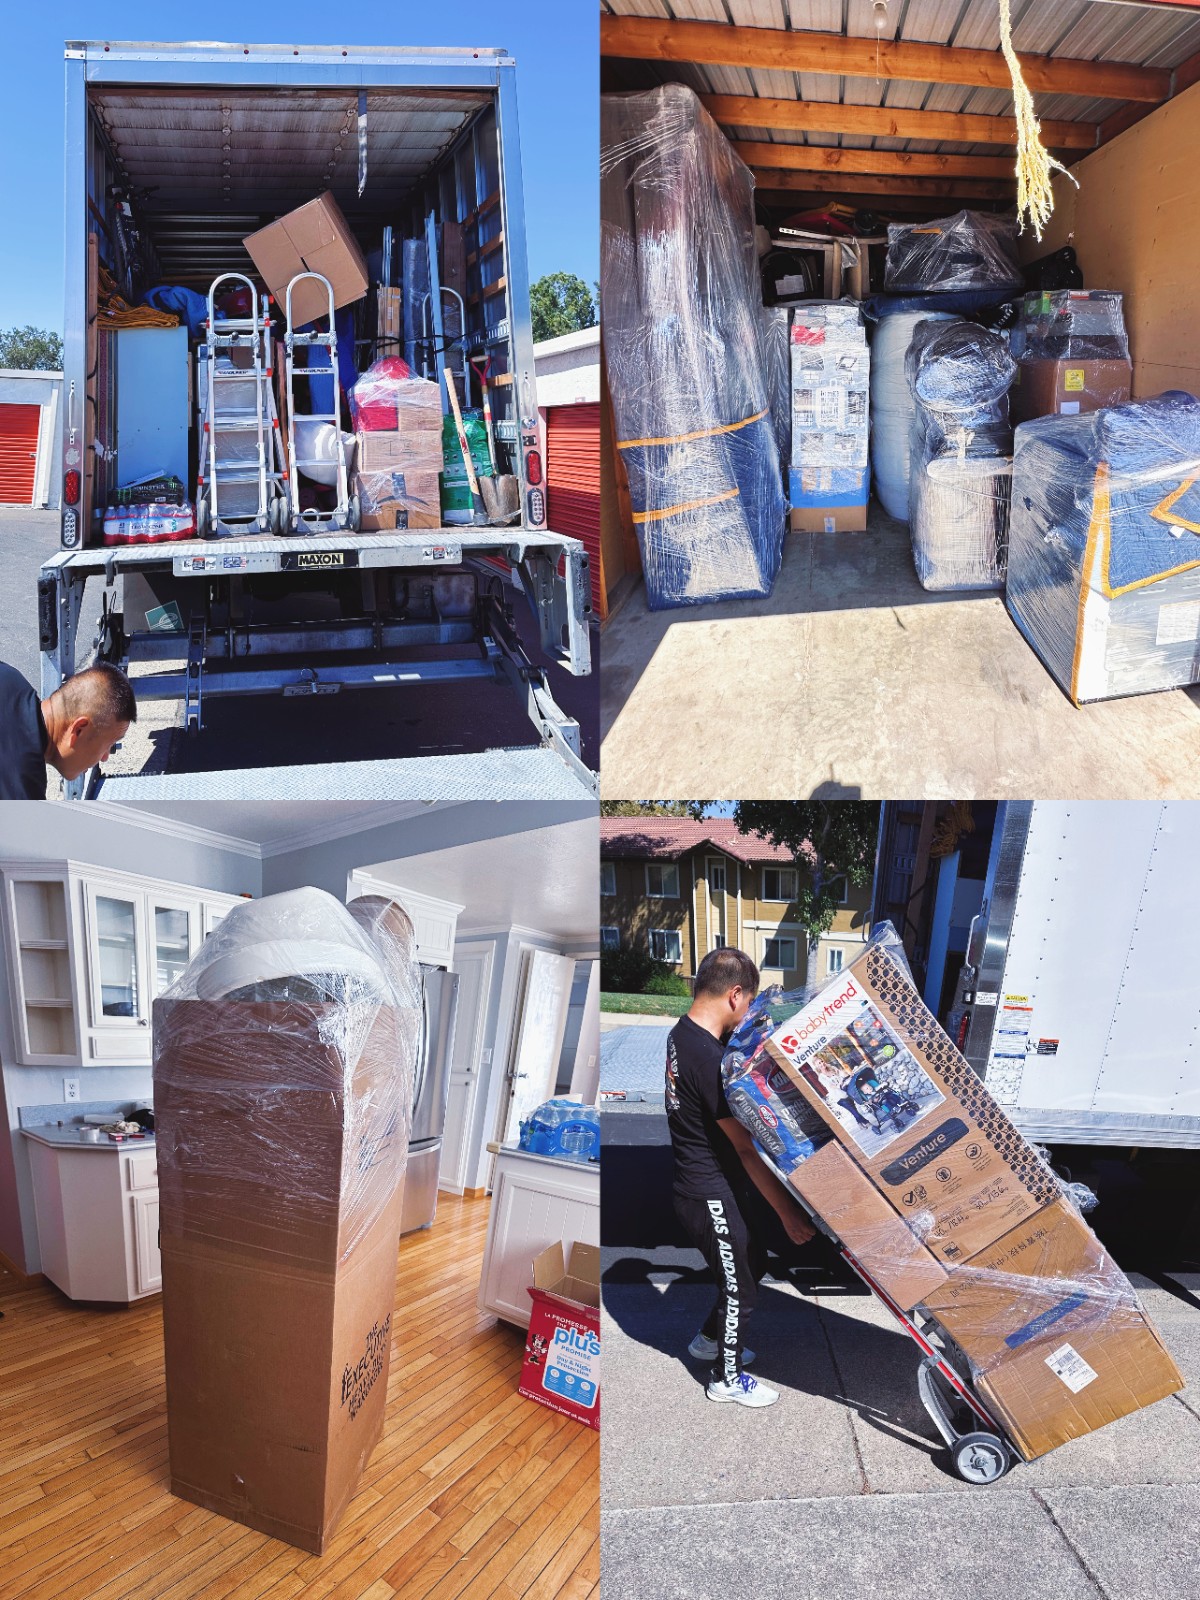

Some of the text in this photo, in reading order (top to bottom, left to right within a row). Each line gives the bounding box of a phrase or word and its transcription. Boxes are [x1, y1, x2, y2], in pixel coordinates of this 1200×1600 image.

[299, 554, 341, 566] MAXON
[794, 981, 858, 1041] babytrend
[793, 1035, 827, 1065] Venture
[735, 1093, 780, 1153] PROFESSIONAL
[898, 1132, 947, 1170] Venture
[717, 1238, 738, 1293] ADIDAS
[723, 1295, 740, 1345] ADIDAS
[554, 1327, 600, 1356] plus
[561, 1344, 592, 1361] PROMISE
